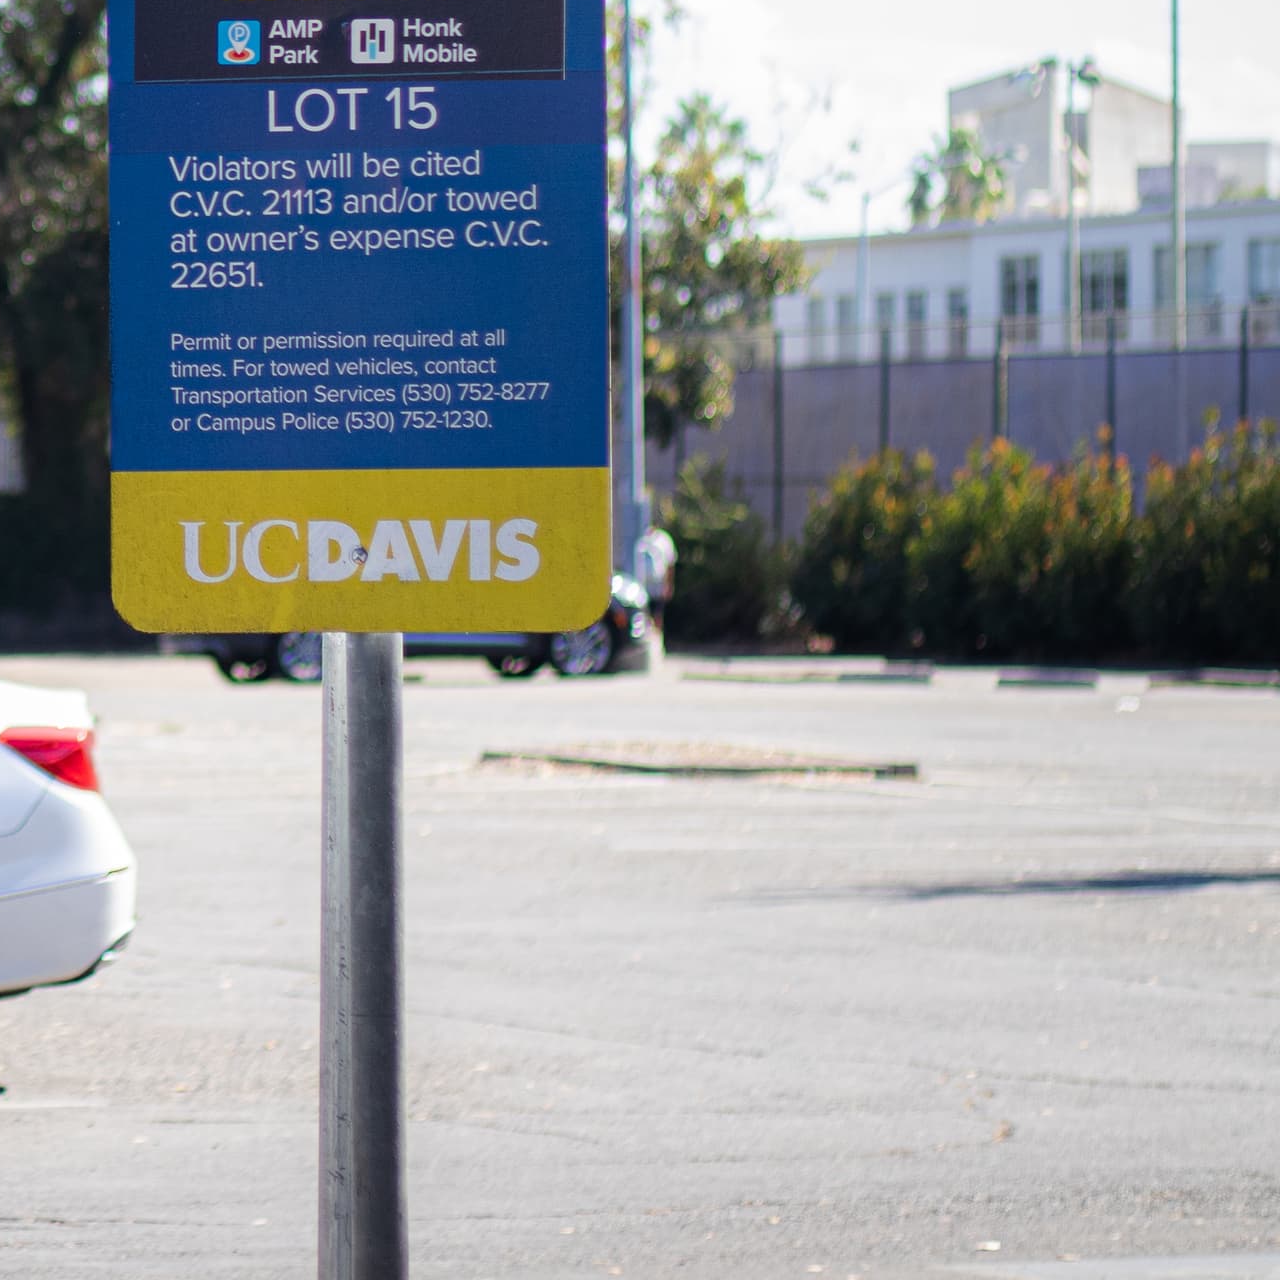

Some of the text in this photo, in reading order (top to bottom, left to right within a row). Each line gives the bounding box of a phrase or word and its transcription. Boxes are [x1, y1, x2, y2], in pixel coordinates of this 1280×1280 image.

[269, 20, 322, 37] AMP
[403, 18, 462, 36] Honk
[269, 46, 318, 63] Park
[403, 44, 477, 63] Mobile
[268, 86, 438, 132] LOT 15
[169, 151, 480, 182] Violators will be cited
[169, 185, 537, 218] C.V.C. 21113 and/or towed
[171, 221, 548, 254] at owner's expense C.V.C.
[171, 263, 263, 289] 22651.
[171, 329, 505, 353] Permit or permission required at all
[171, 357, 496, 378] times. For towed vehicles, contact
[171, 383, 549, 408] Transportation Services (530) 752-8277
[171, 411, 492, 434] or Campus Police (530) 752-1230.
